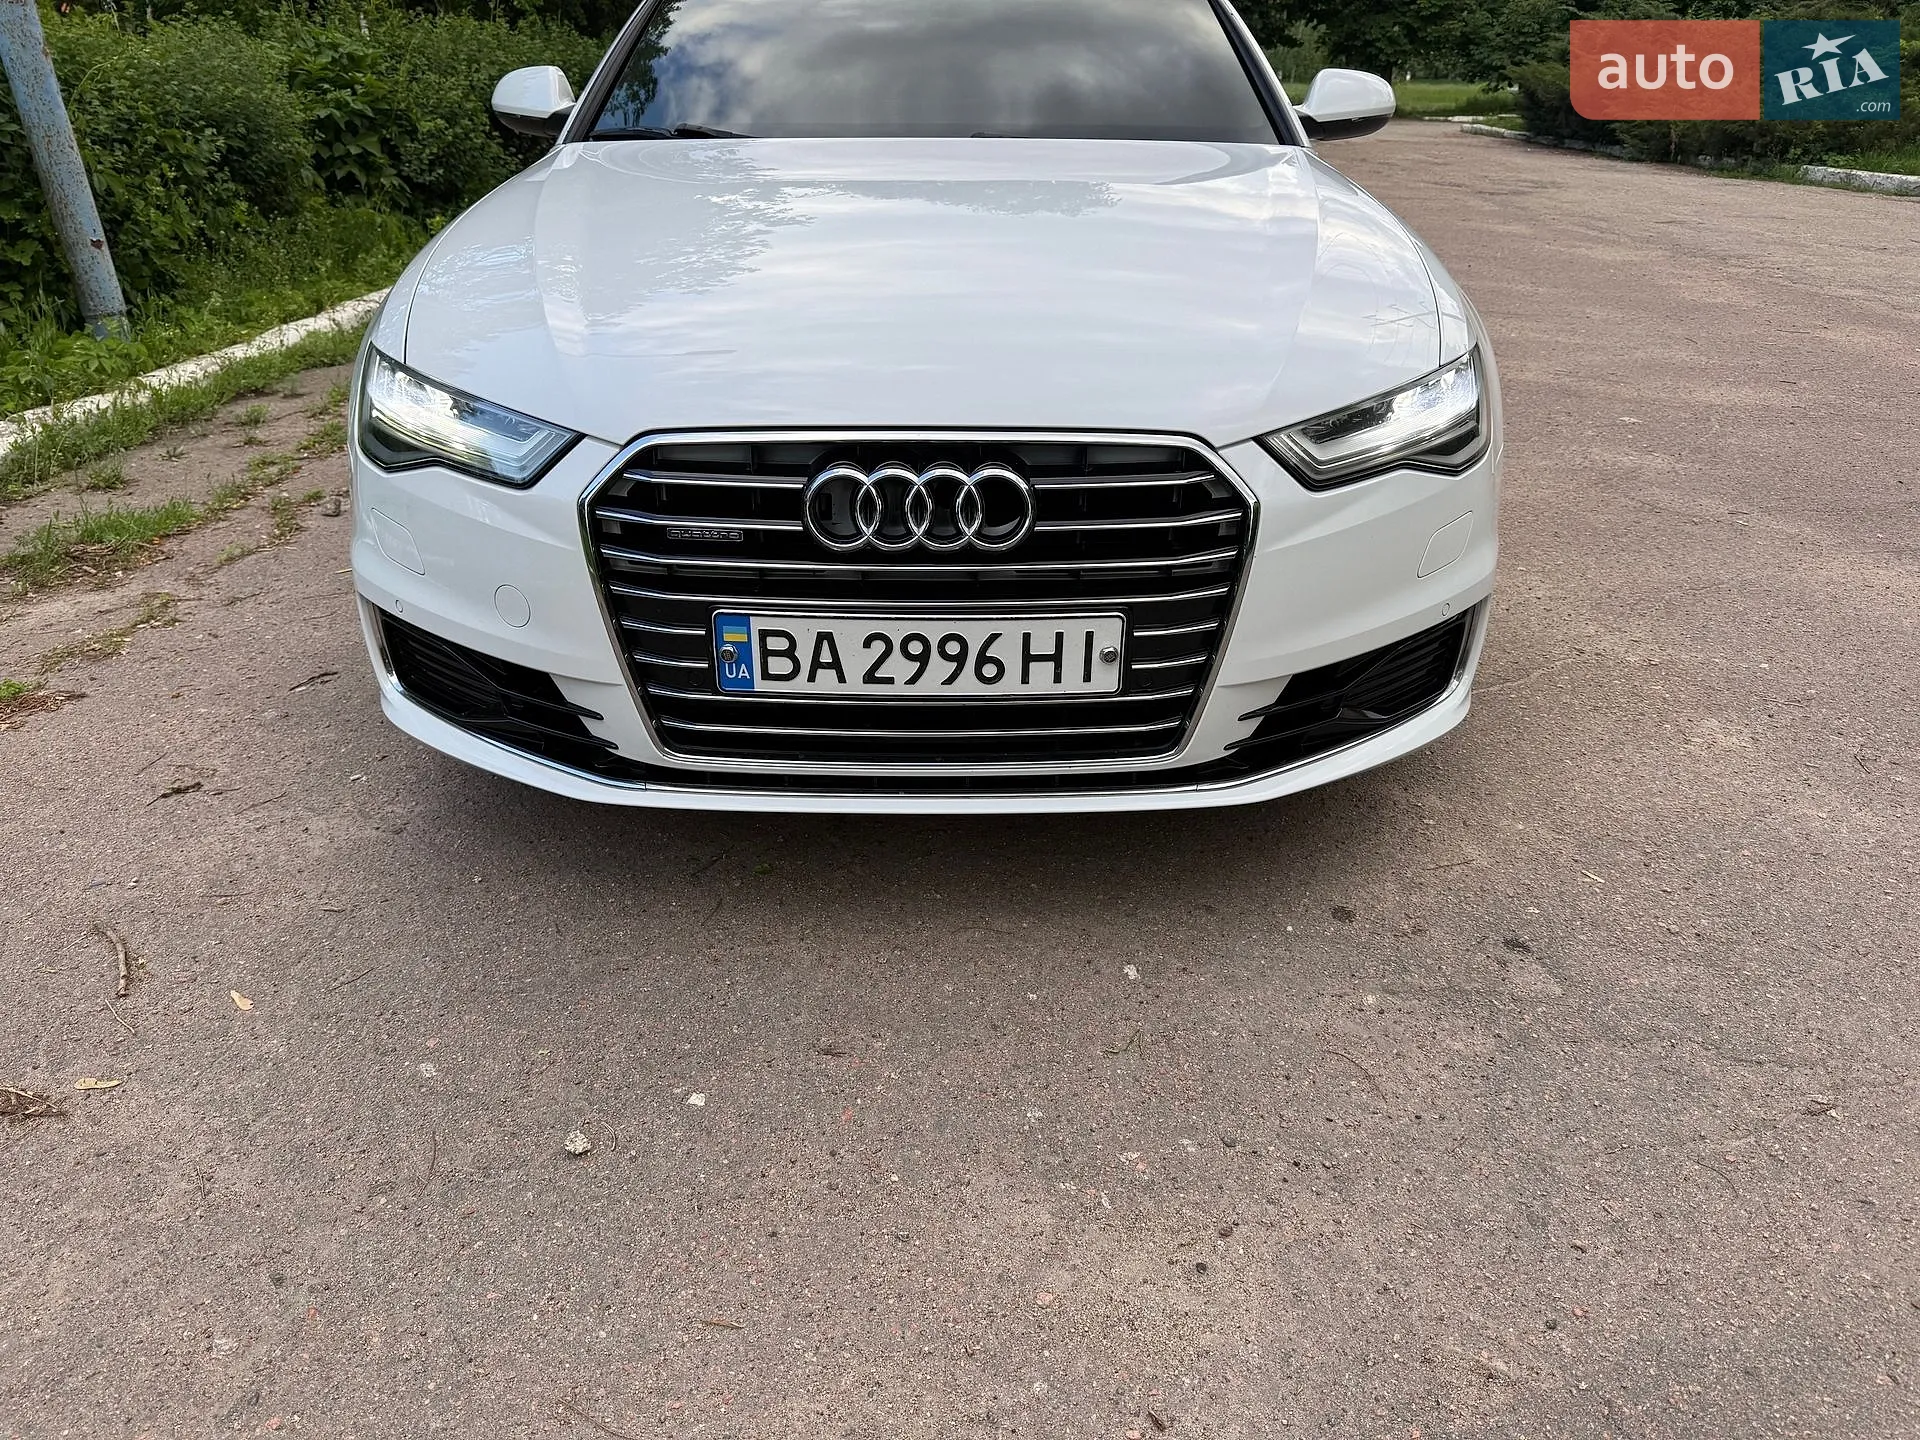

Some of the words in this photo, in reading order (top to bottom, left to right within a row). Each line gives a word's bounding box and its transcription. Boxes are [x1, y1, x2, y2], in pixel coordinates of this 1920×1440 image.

[670, 529, 740, 539] quattro
[757, 628, 847, 684] BA
[862, 631, 1006, 686] 2996
[1020, 630, 1095, 685] HI
[725, 662, 751, 680] UA
